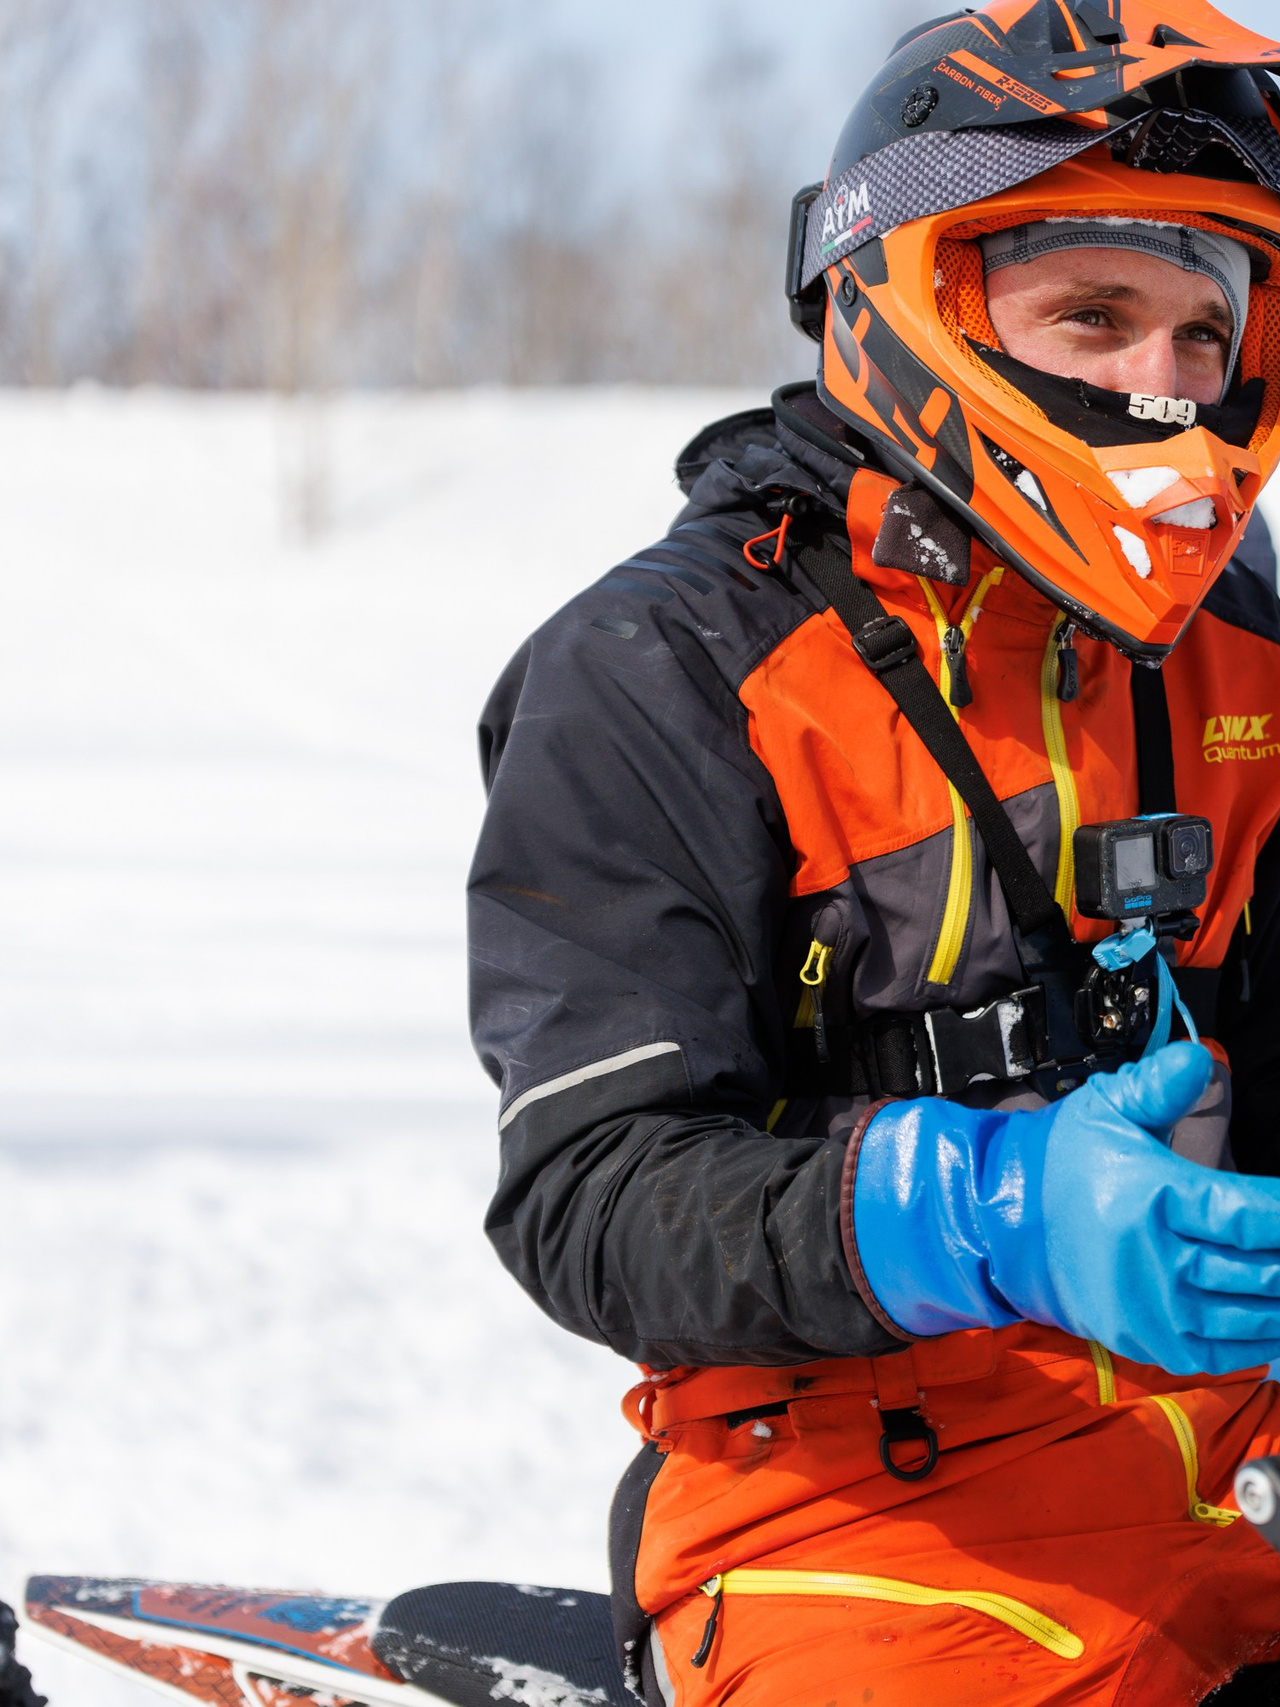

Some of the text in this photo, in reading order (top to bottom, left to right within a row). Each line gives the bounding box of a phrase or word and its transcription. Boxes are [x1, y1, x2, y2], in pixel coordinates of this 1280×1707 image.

[937, 62, 1003, 107] CARBON FIBER
[1128, 393, 1197, 425] 509
[1202, 713, 1273, 747] LYNX
[1124, 894, 1152, 903] GoPro
